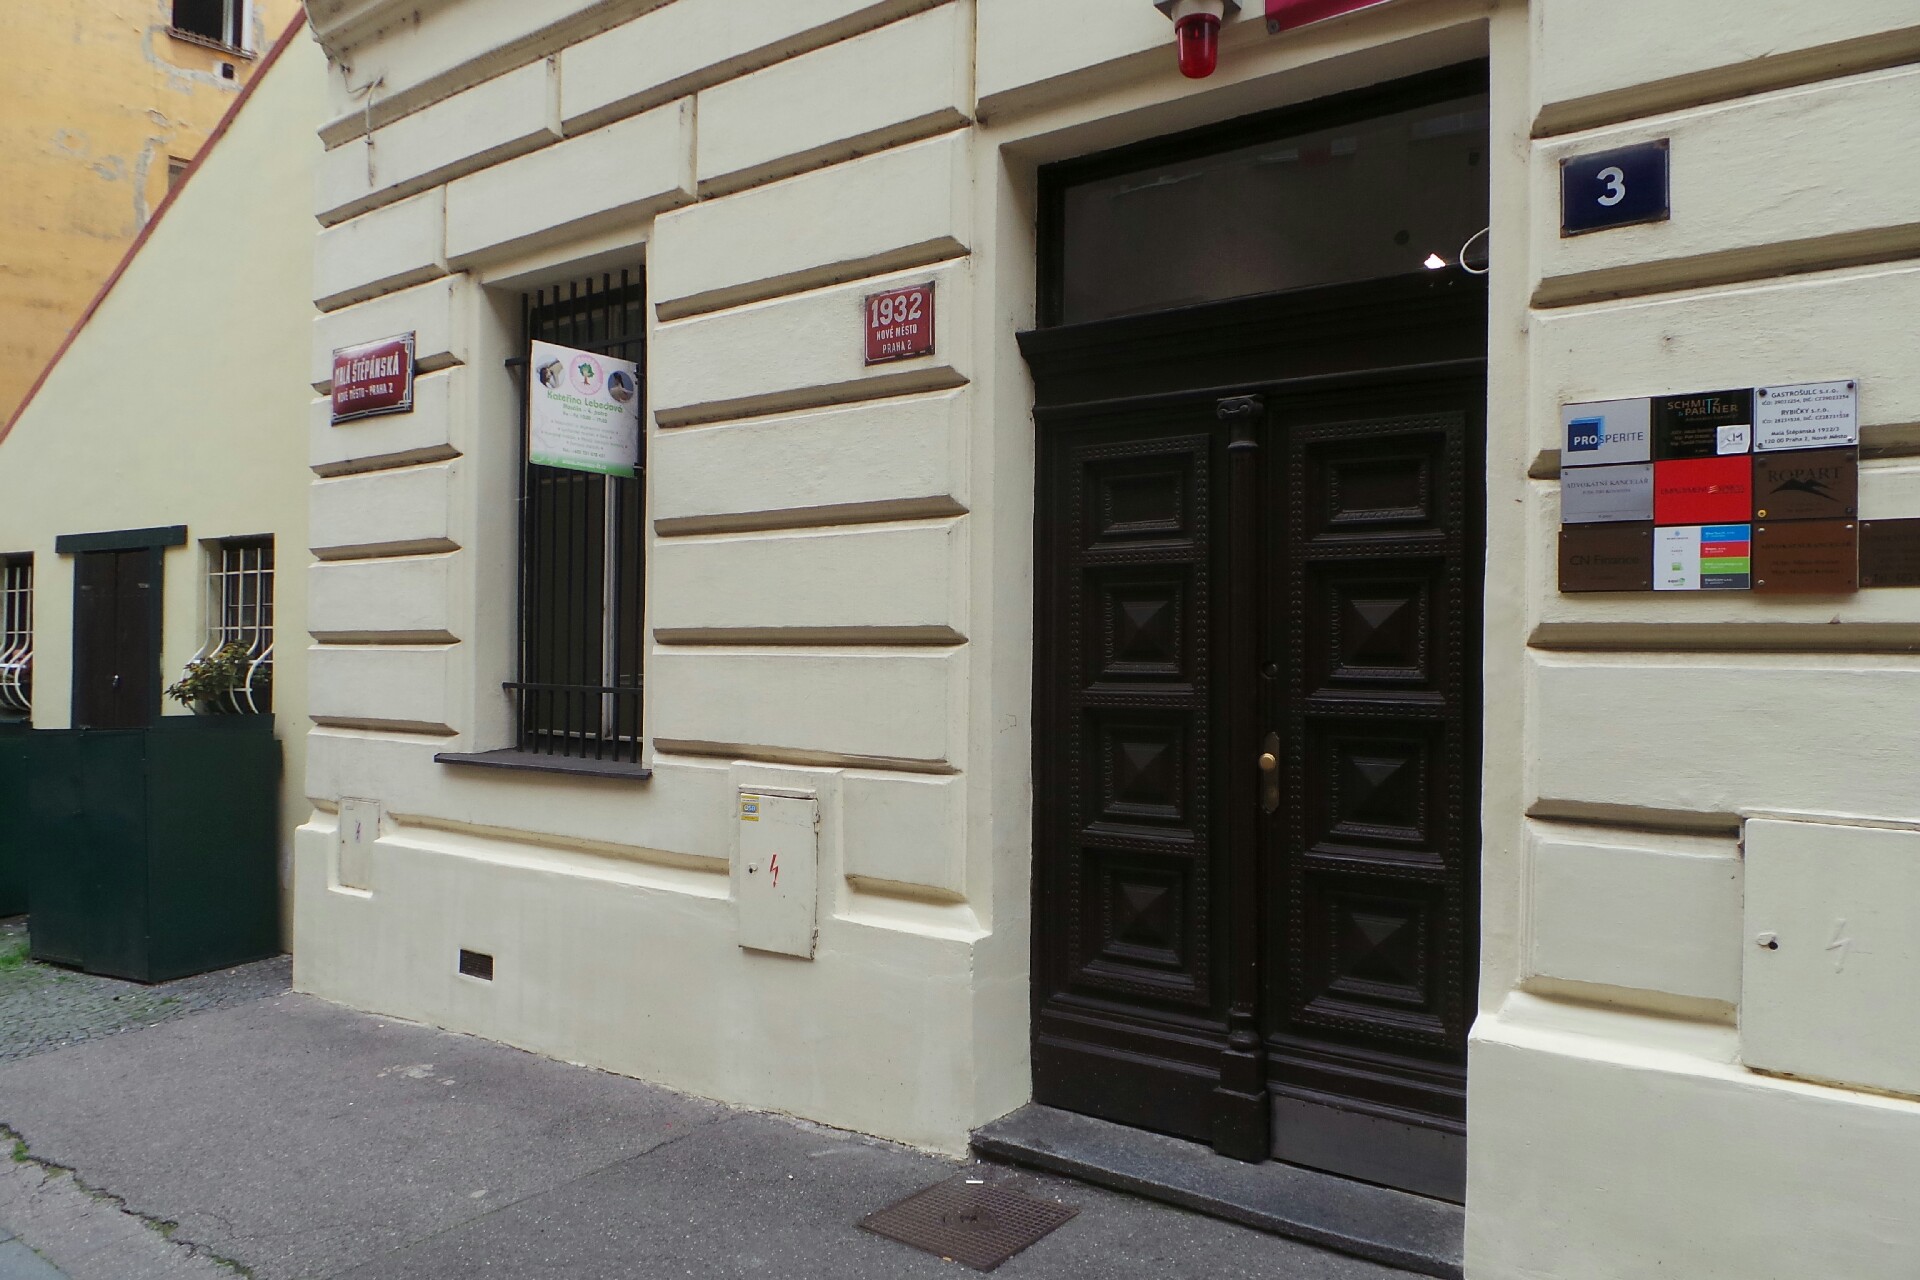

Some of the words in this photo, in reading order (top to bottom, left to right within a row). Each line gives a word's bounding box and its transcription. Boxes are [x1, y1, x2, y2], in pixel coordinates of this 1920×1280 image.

[1596, 166, 1626, 206] 3
[871, 292, 922, 328] 1932
[876, 325, 894, 341] NOVÉ
[895, 323, 918, 338] MĚSTO
[882, 341, 906, 354] PRAHA
[907, 340, 912, 350] 2
[351, 351, 399, 383] ŠTĚPÁNSKÁ
[369, 382, 388, 396] PRAHA
[388, 382, 394, 394] 2
[1667, 398, 1720, 411] SCHMITZ
[1685, 402, 1739, 416] PARTNER
[1574, 431, 1644, 446] PROSPERITE
[1768, 466, 1843, 482] ROPART
